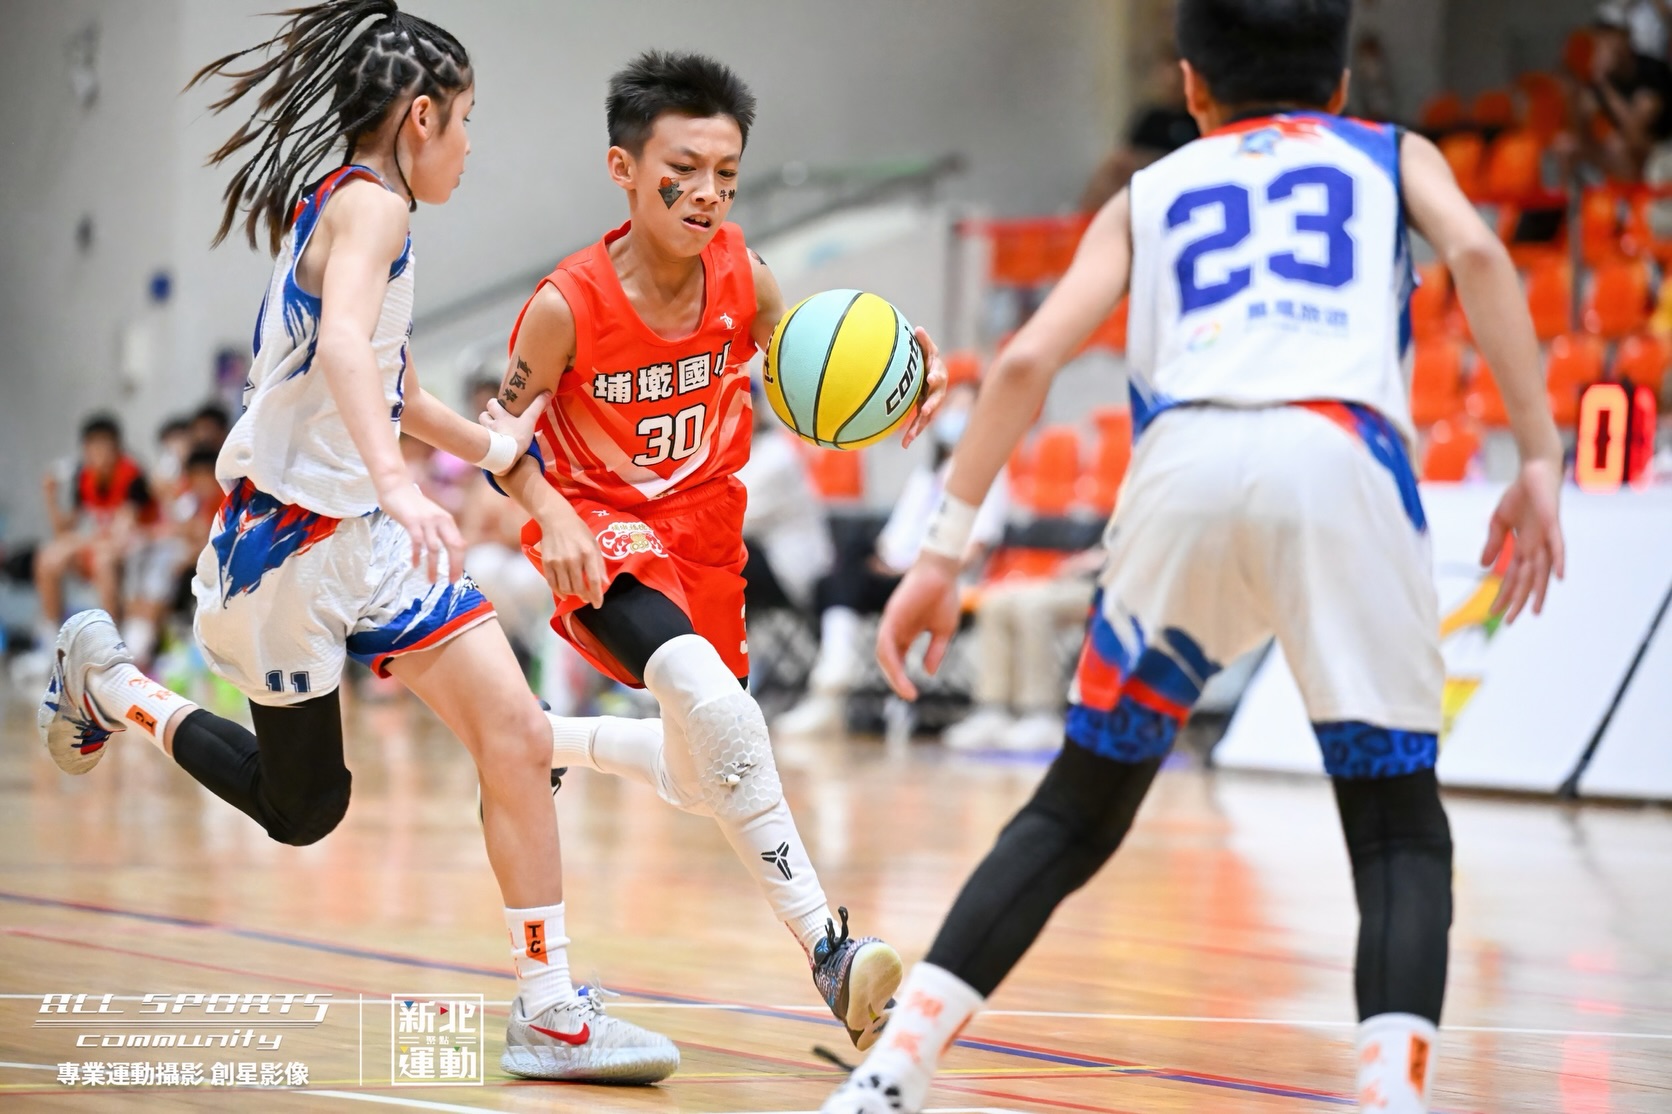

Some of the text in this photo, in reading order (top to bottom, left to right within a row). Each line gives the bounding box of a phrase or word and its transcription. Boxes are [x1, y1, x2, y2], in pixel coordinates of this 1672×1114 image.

[1166, 166, 1354, 316] 23
[632, 402, 706, 467] 30
[265, 669, 311, 692] 11
